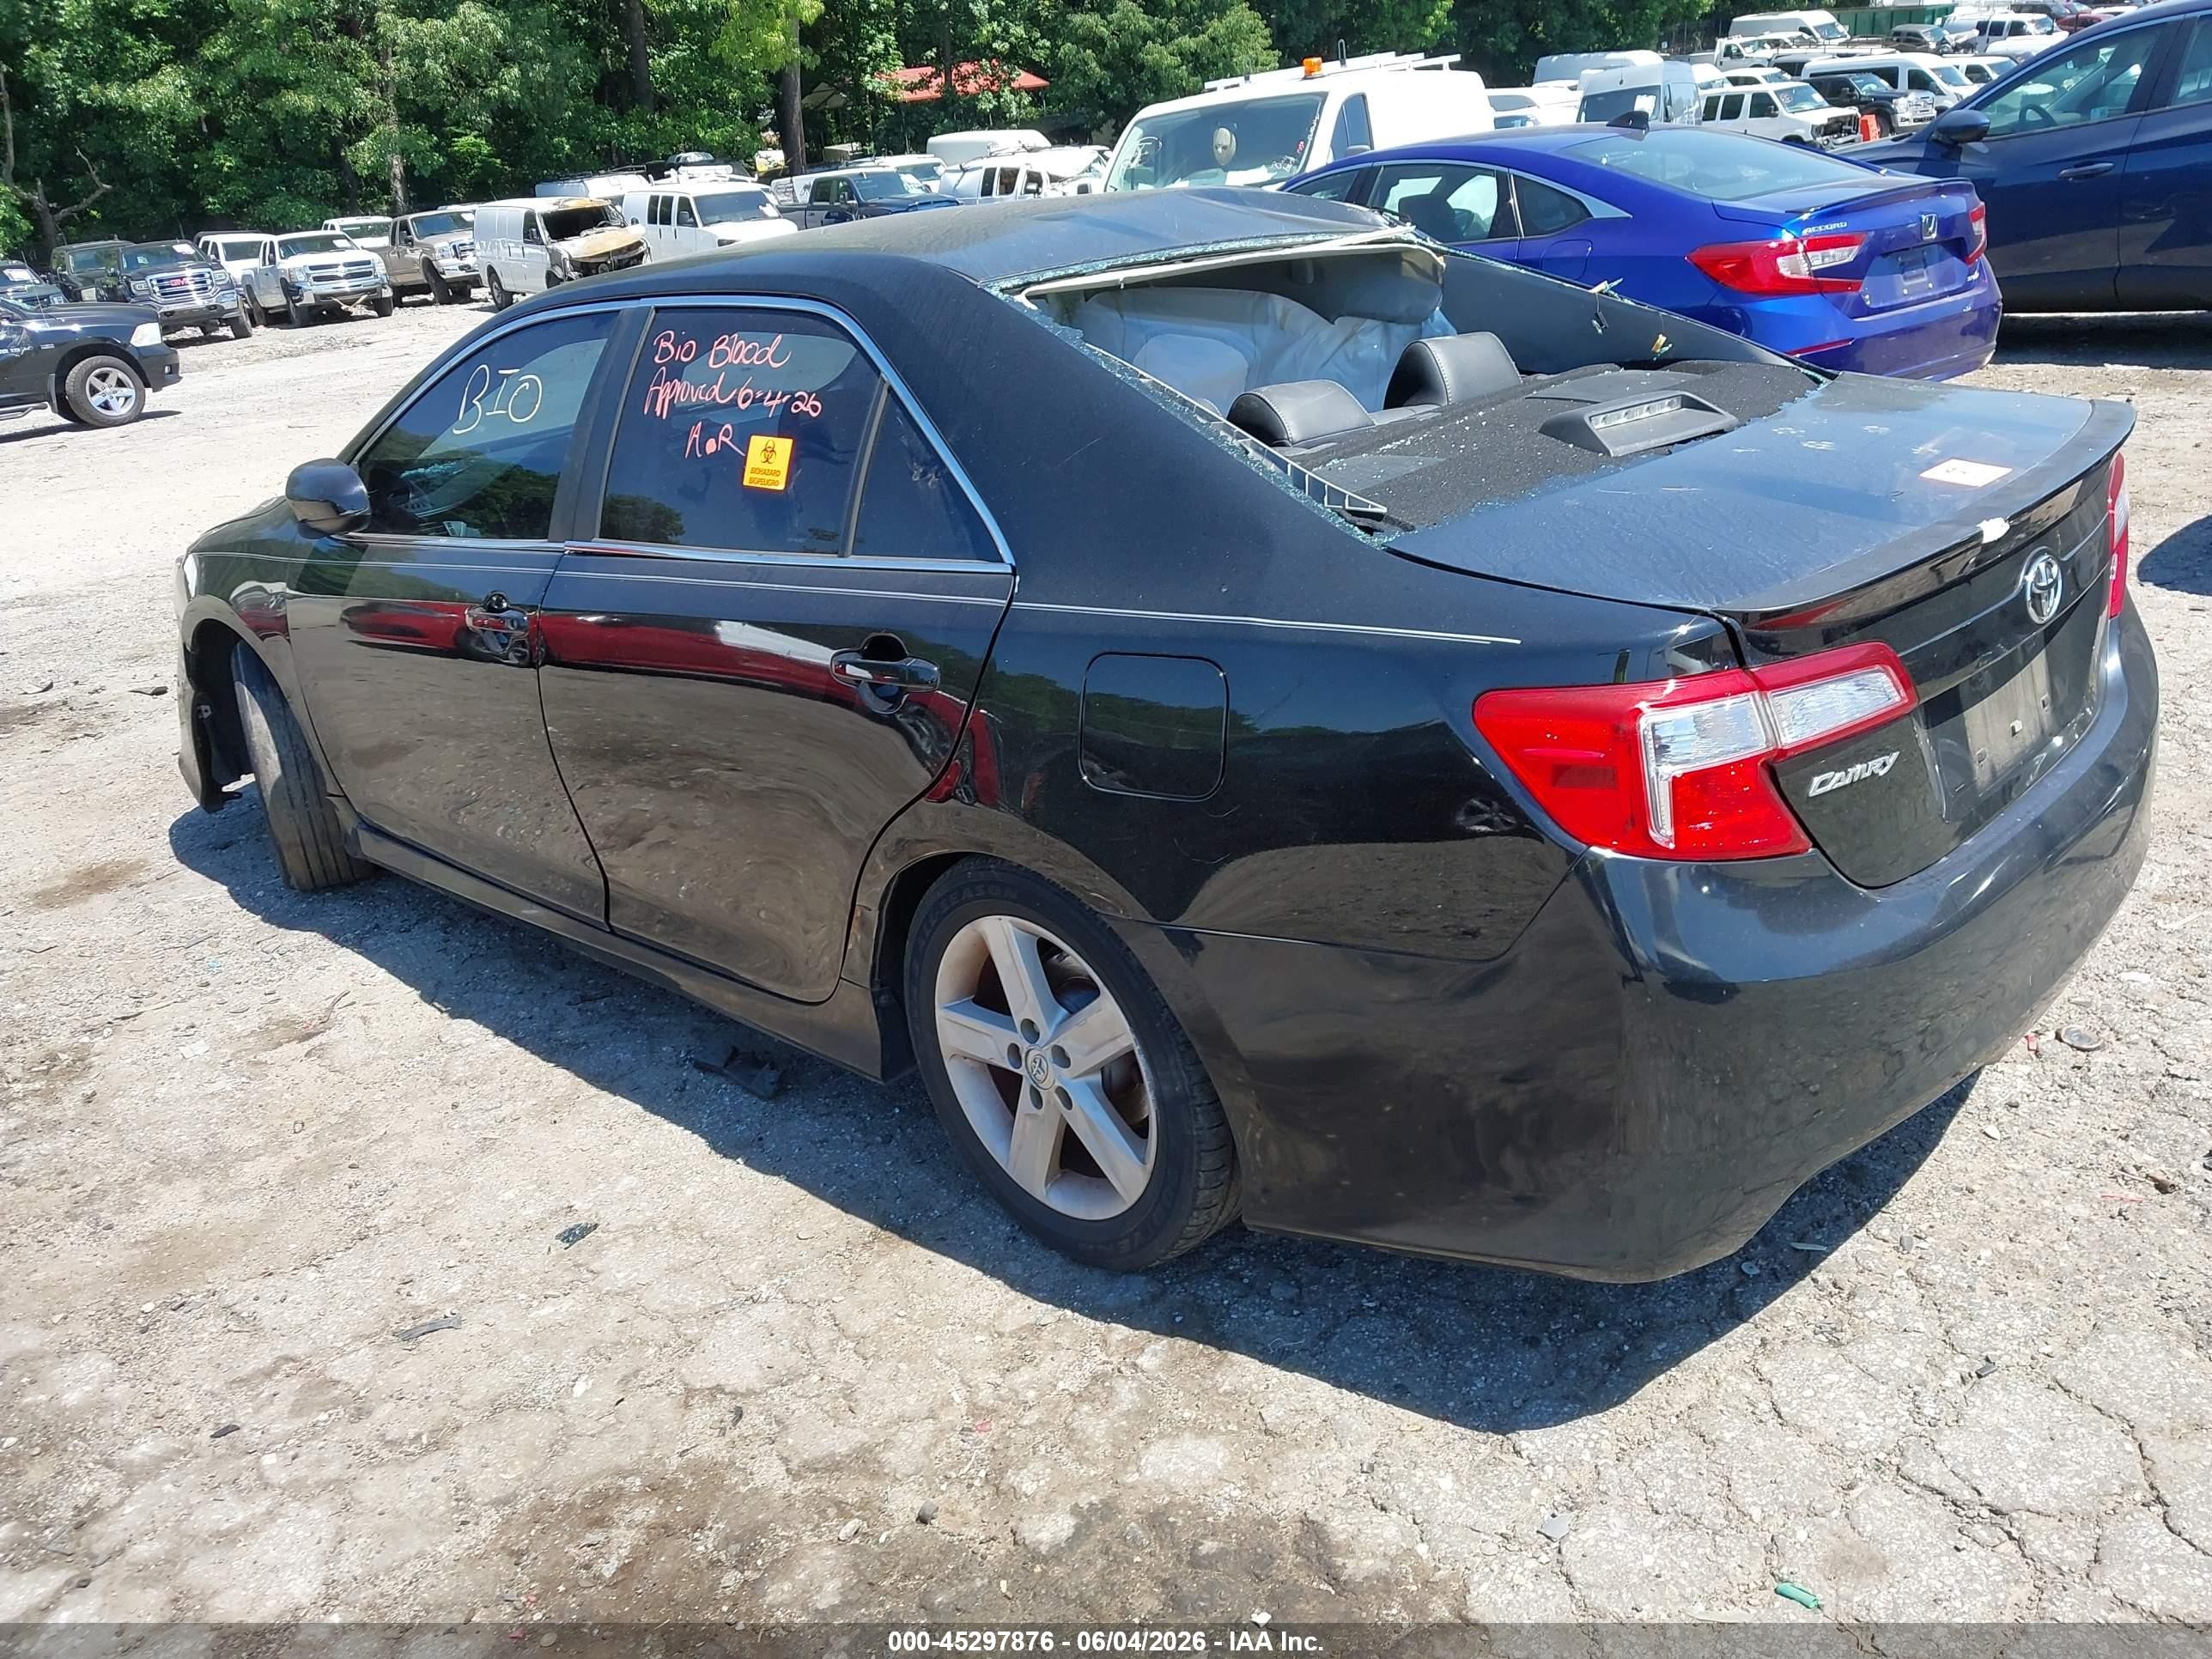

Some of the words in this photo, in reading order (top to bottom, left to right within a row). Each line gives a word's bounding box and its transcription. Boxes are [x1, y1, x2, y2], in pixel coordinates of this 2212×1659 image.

[1802, 222, 1848, 236] ACCORD
[653, 330, 697, 364] Bio
[708, 333, 792, 368] Blood
[452, 363, 543, 435] BIO
